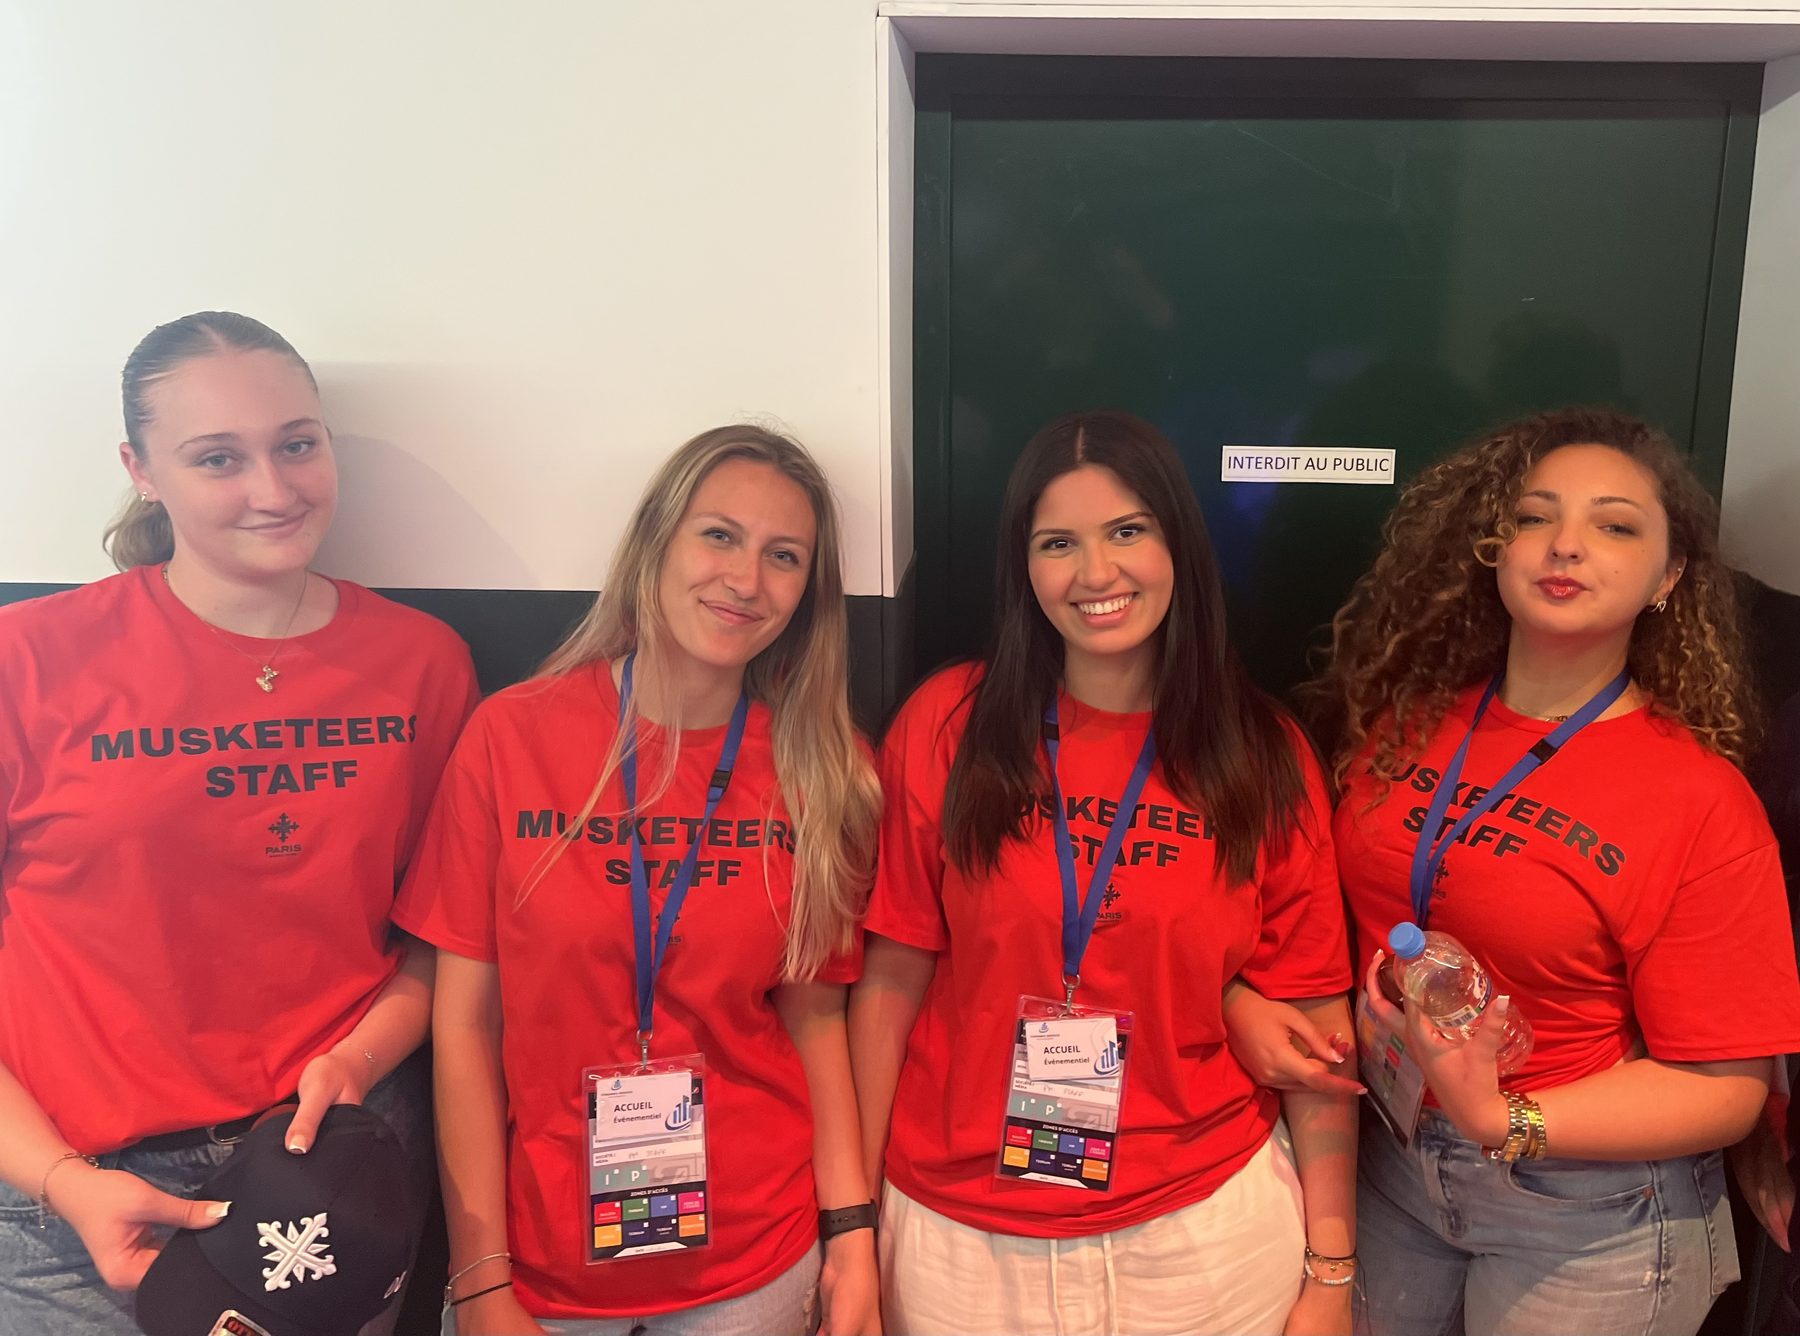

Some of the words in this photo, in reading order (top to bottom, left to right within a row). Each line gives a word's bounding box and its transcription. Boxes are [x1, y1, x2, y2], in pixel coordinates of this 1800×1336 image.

[1228, 456, 1300, 470] INTERDIT
[1304, 457, 1328, 471] AU
[1333, 458, 1390, 472] PUBLIC
[206, 759, 358, 798] STAFF
[265, 844, 301, 855] PARIS
[1043, 1045, 1081, 1054] ACCUEIL
[1044, 1057, 1090, 1065] Événementiel
[613, 1101, 653, 1112] ACCUEIL
[1045, 1104, 1054, 1116] P
[613, 1112, 662, 1124] Événementiel
[631, 1170, 640, 1181] P
